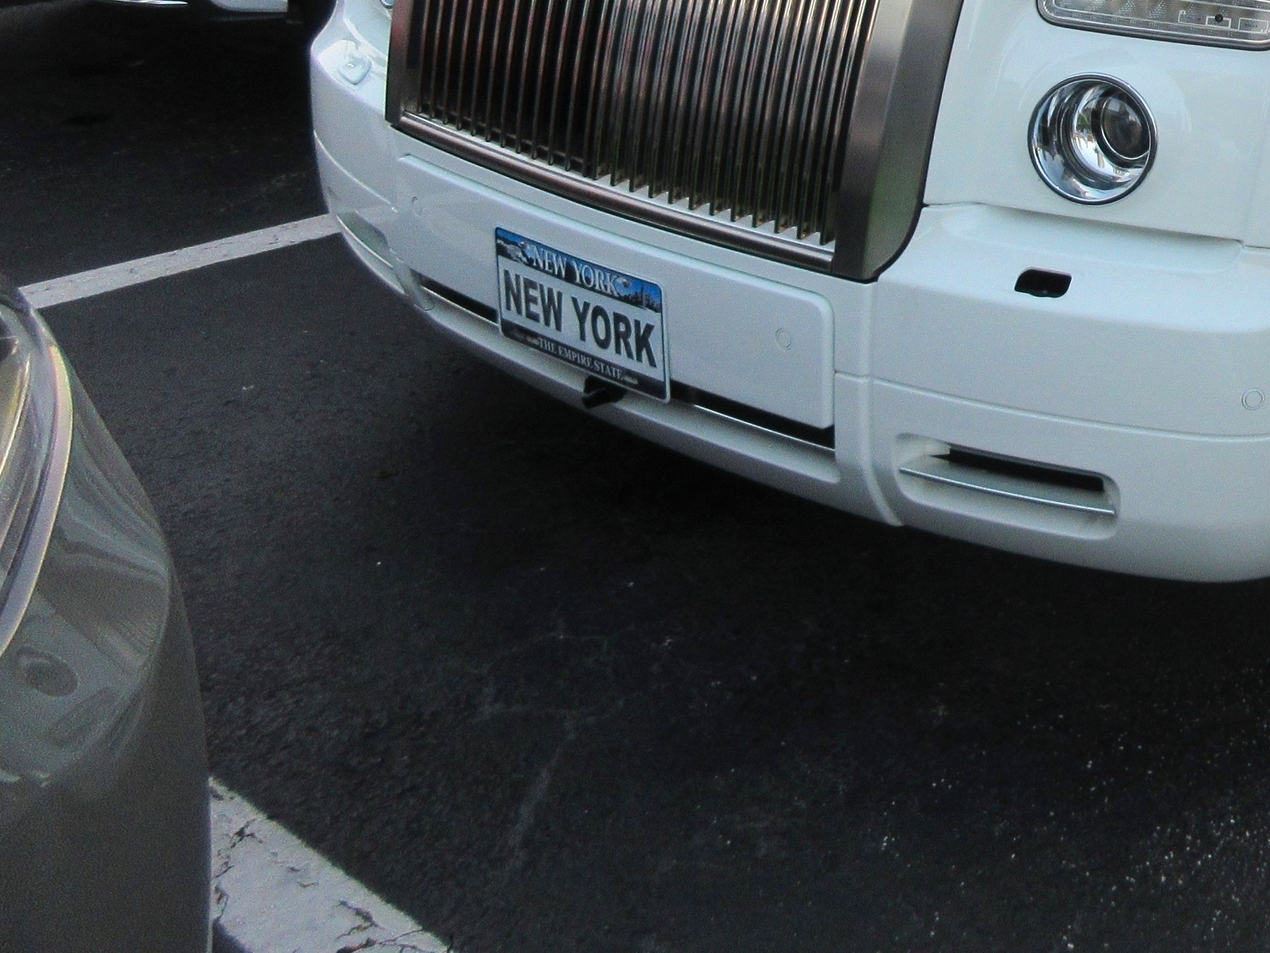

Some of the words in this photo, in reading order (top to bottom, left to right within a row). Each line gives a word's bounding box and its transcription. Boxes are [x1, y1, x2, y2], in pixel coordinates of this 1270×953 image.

[532, 247, 568, 279] NEW
[571, 260, 621, 297] YORK
[503, 268, 563, 333] NEW
[571, 295, 658, 369] YORK
[538, 337, 558, 356] THE
[558, 343, 592, 368] EMPIRE
[593, 357, 624, 381] STATE
